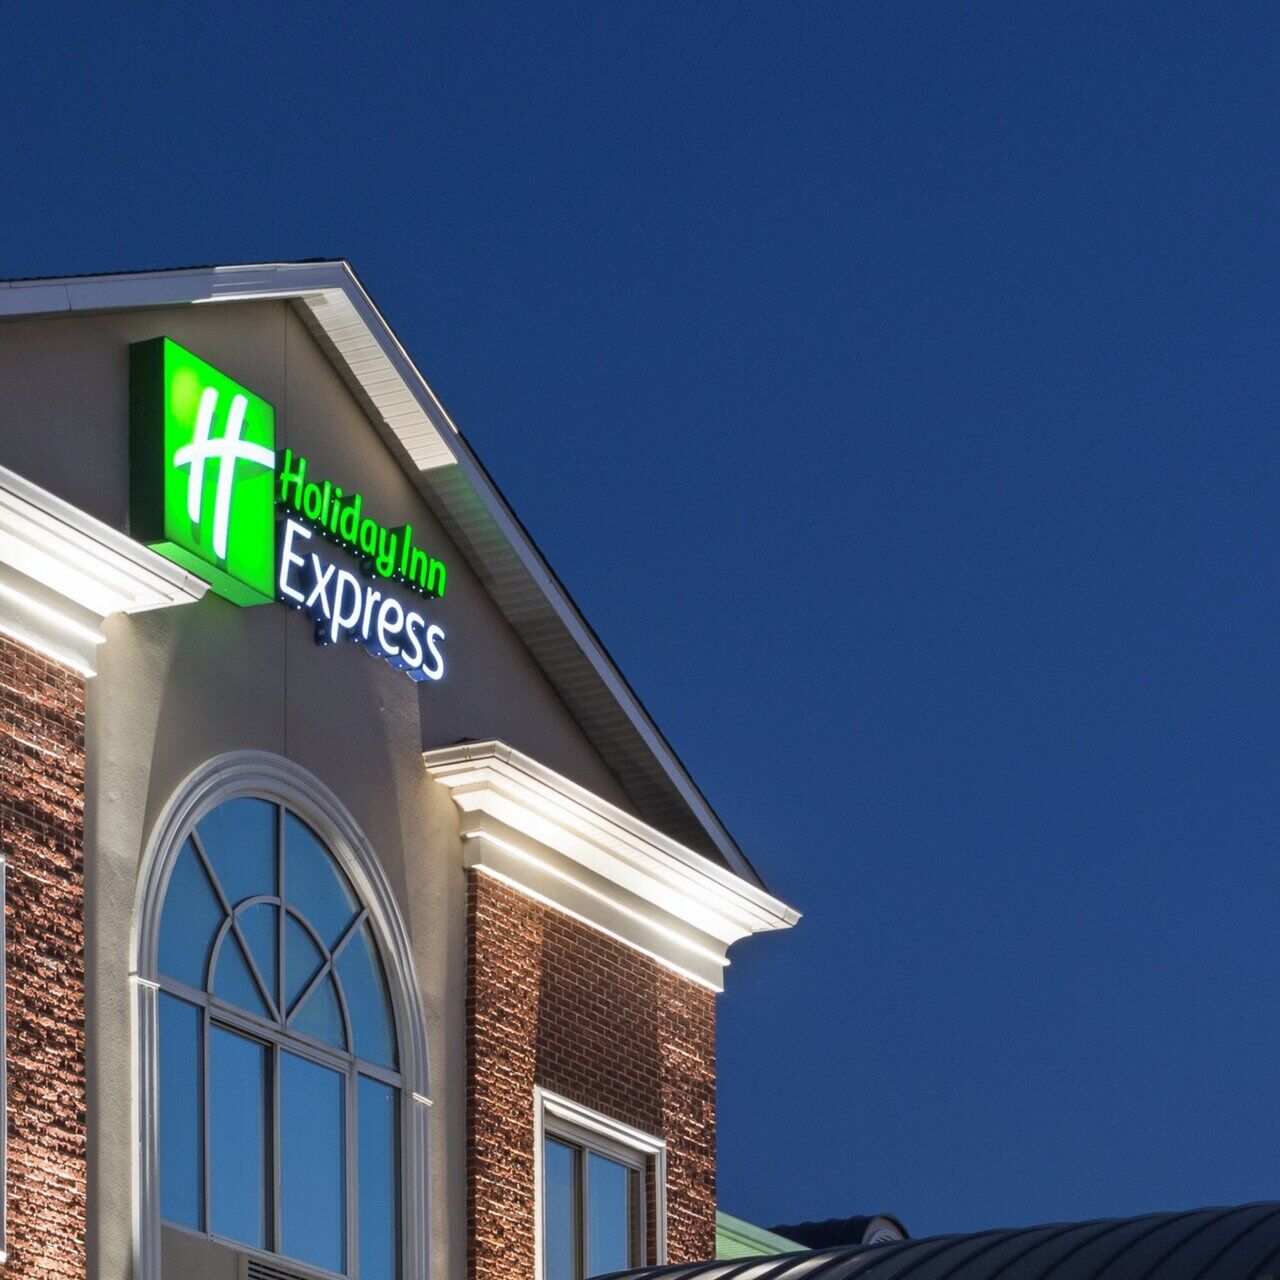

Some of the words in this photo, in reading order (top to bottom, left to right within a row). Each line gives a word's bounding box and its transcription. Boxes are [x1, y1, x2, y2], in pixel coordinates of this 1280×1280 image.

[279, 518, 446, 681] Express
[280, 448, 398, 578] Holiday
[398, 523, 447, 598] Inn
